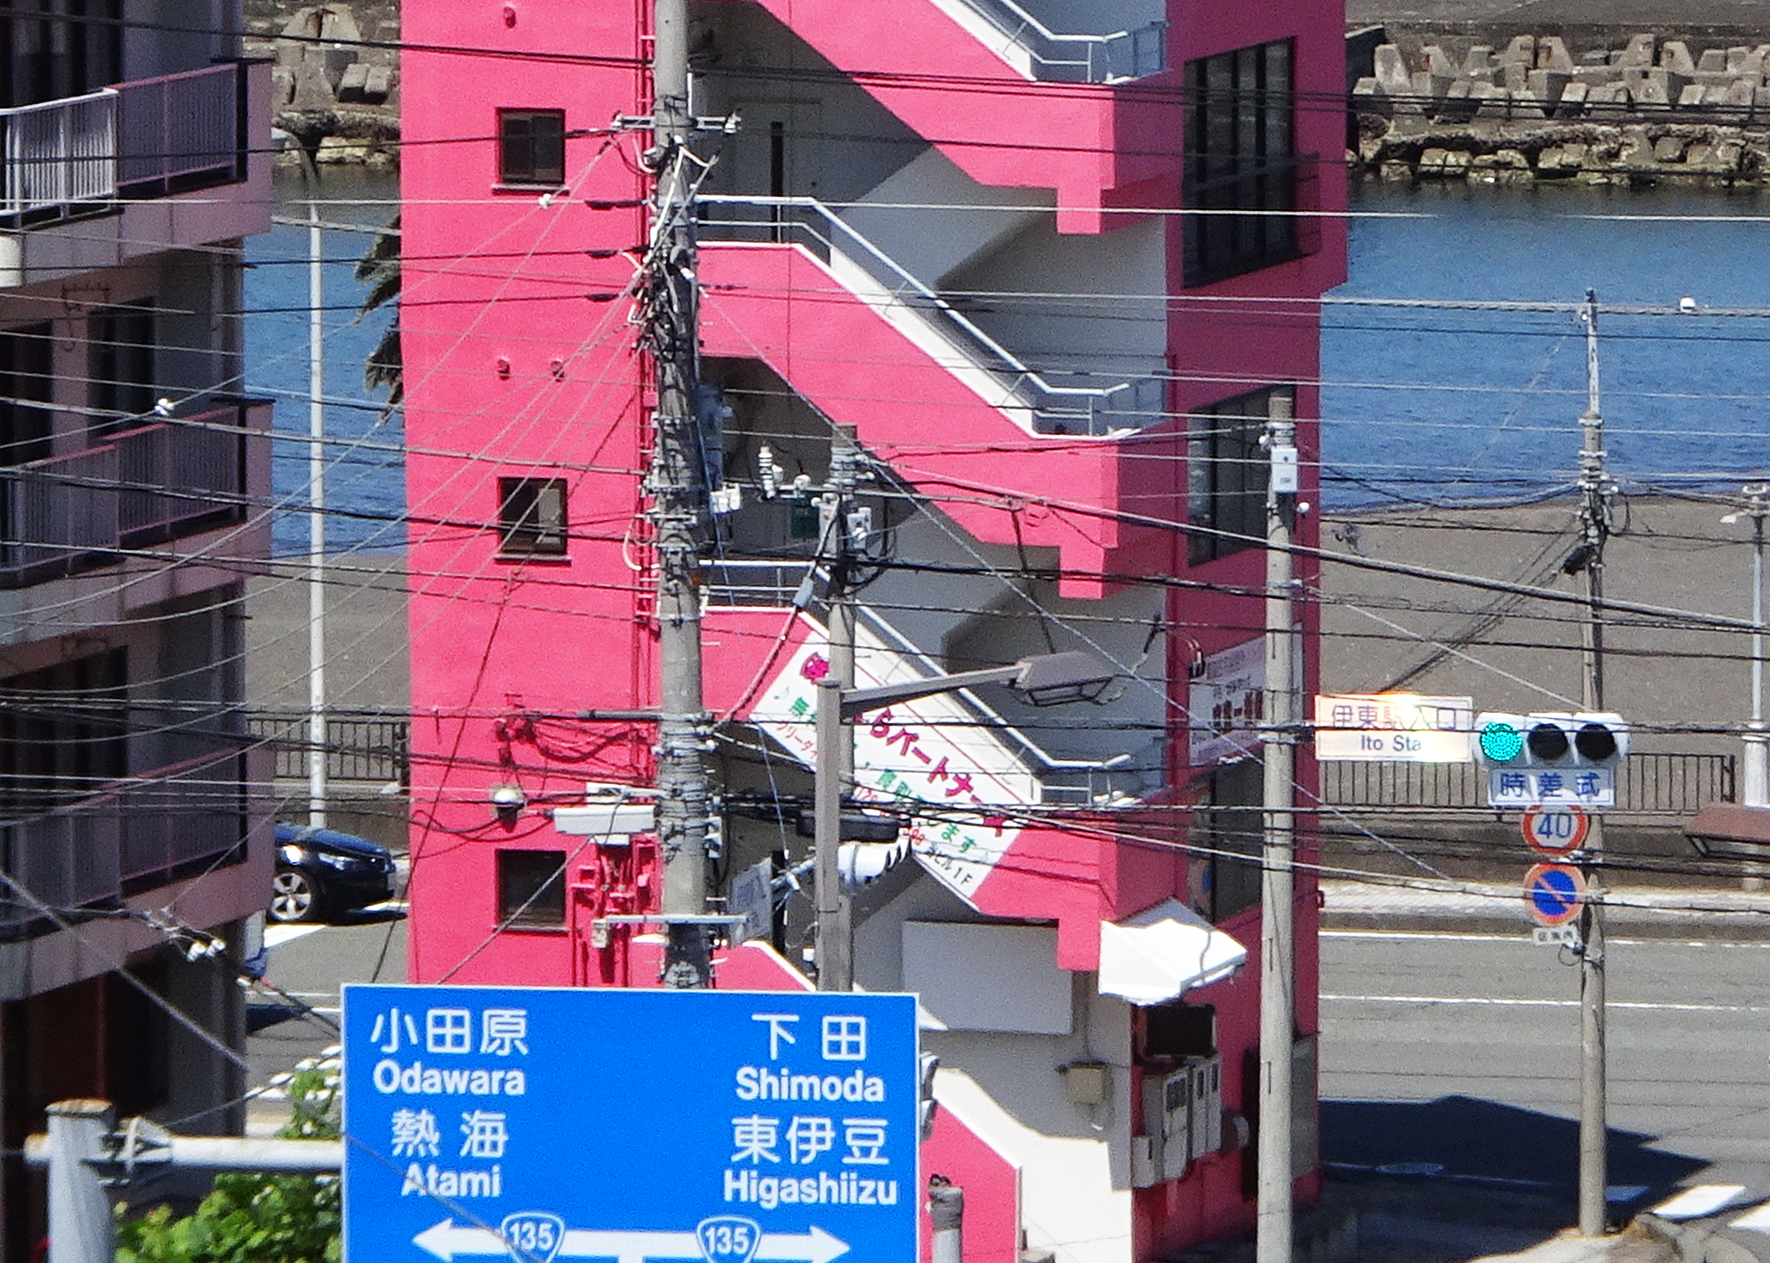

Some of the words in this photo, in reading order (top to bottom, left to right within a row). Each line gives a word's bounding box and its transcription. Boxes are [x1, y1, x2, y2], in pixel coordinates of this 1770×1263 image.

[1361, 735, 1383, 751] Ito
[1501, 772, 1601, 797] 時差式
[1538, 813, 1571, 840] 40
[371, 1008, 528, 1055] 小田原
[751, 1014, 866, 1060] 下田
[373, 1059, 525, 1095] Odawara
[736, 1066, 884, 1102] Shimoda
[391, 1108, 509, 1157] 熱海
[731, 1114, 889, 1164] 東伊豆
[401, 1162, 500, 1198] Atami
[724, 1169, 897, 1209] Higashiizu
[509, 1222, 552, 1250] 135
[706, 1226, 749, 1254] 135
